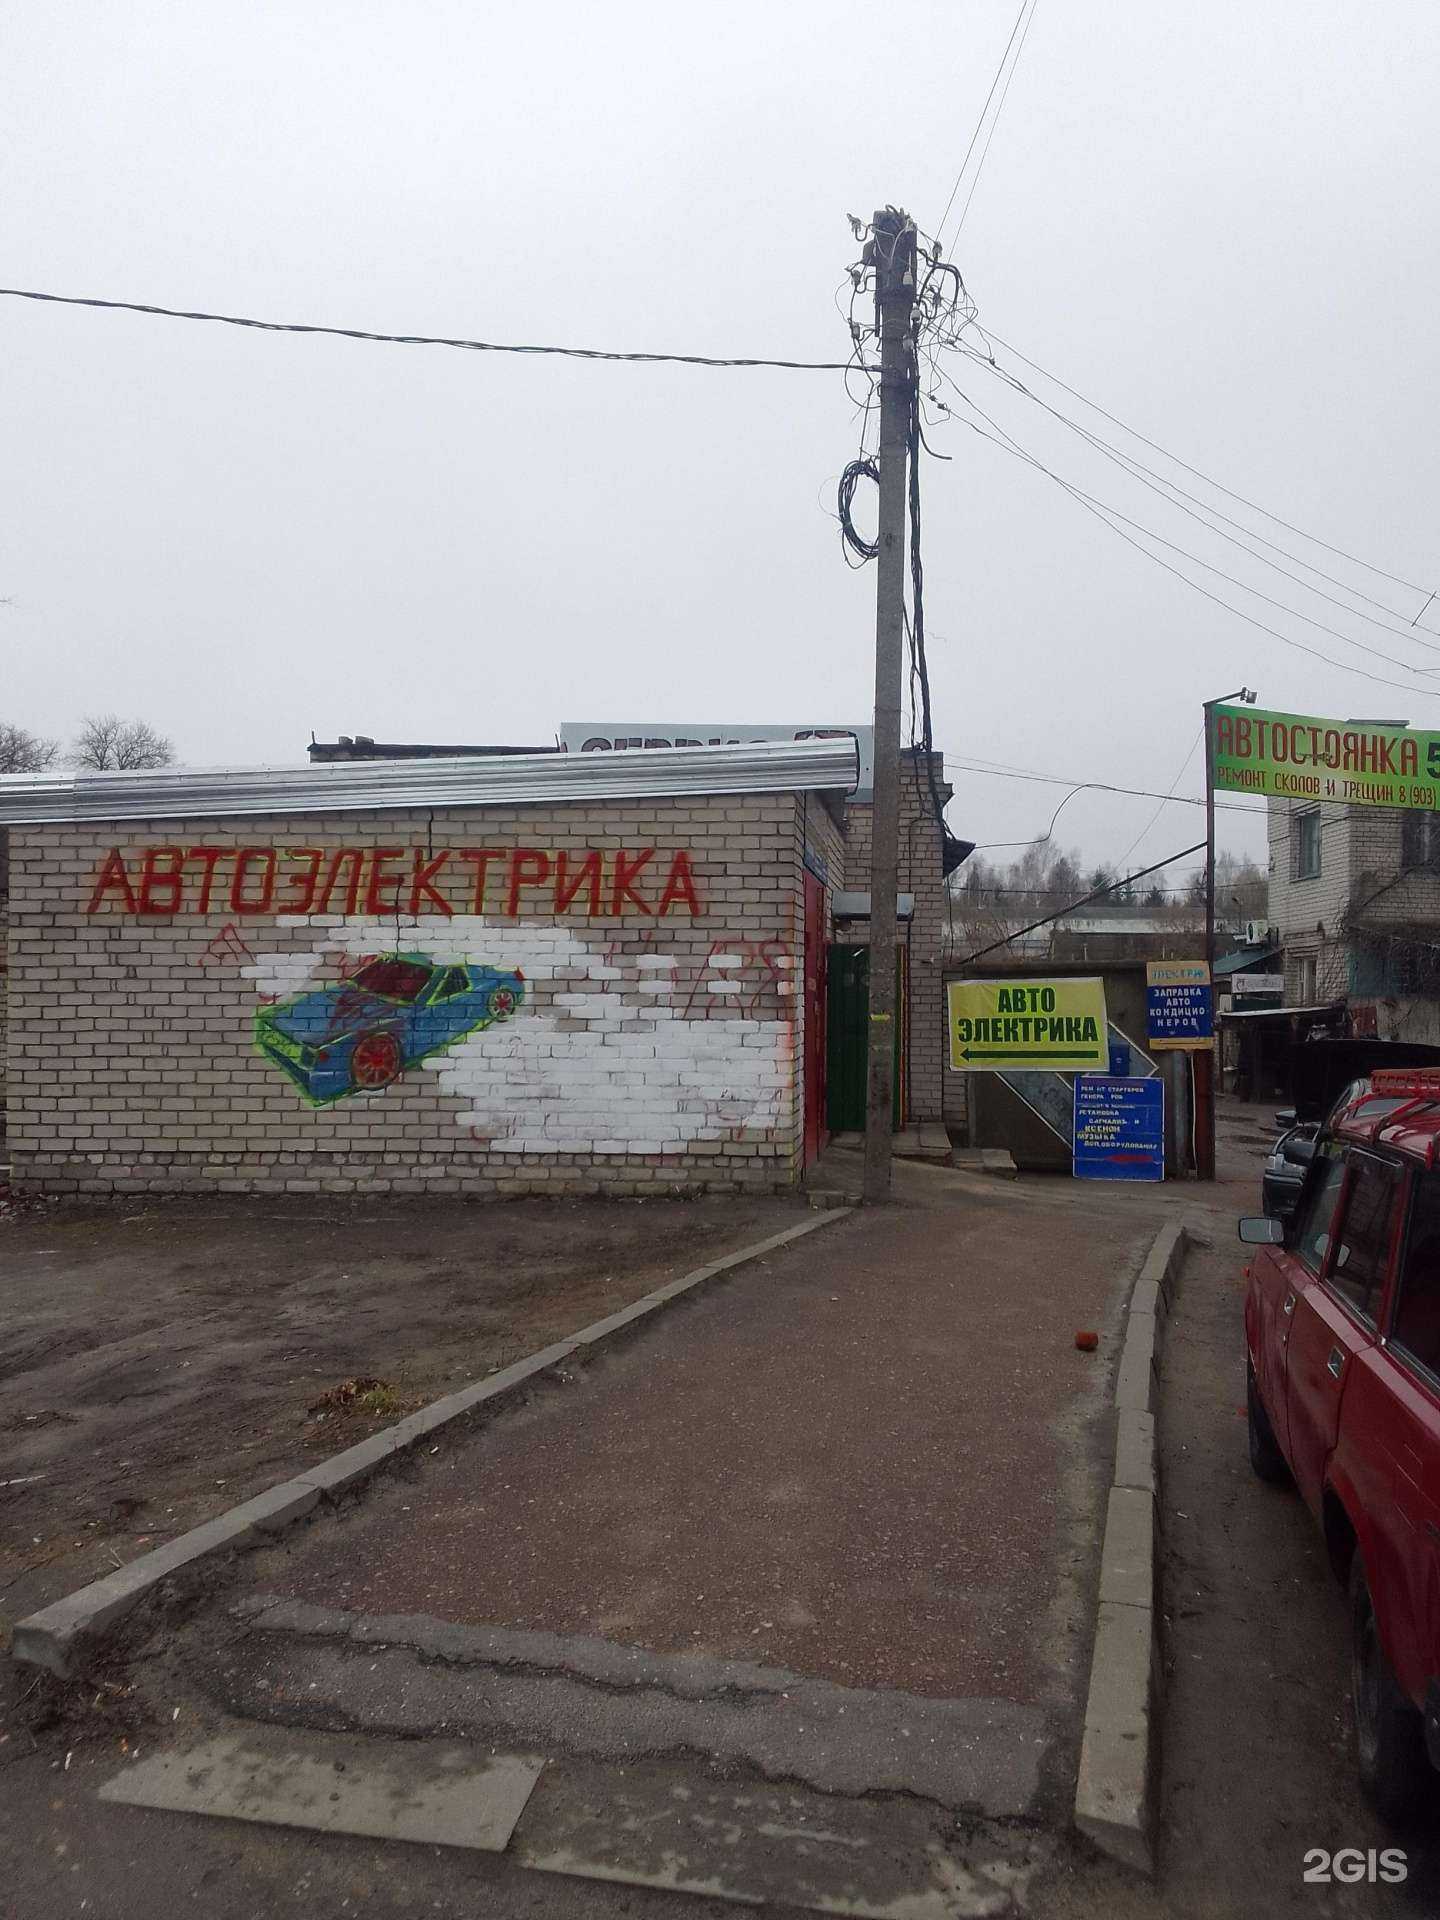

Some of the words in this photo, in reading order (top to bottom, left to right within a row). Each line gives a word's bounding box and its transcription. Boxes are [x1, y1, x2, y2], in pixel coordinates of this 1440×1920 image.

[1216, 715, 1419, 777] АВТОСТОЯНКА
[1217, 767, 1267, 788] РЕМОНТ
[1274, 772, 1320, 795] СКОЛОВ
[1326, 779, 1336, 796] И
[1343, 780, 1393, 804] ТРЕЩИН
[1399, 785, 1407, 803] 8
[1409, 785, 1437, 809] (903)
[87, 847, 702, 917] АВТОЭЛЕКТРИКА
[998, 987, 1056, 1013] АВТО
[1153, 988, 1202, 997] ЗАПРАВКА
[1166, 998, 1191, 1006] АВТО
[1150, 1008, 1205, 1018] КОНДИЦИО
[958, 1016, 1099, 1043] ЭЛЕКТРИКА
[1157, 1018, 1197, 1027] НЕРОВ
[1077, 1132, 1116, 1140] МУЗЫКА
